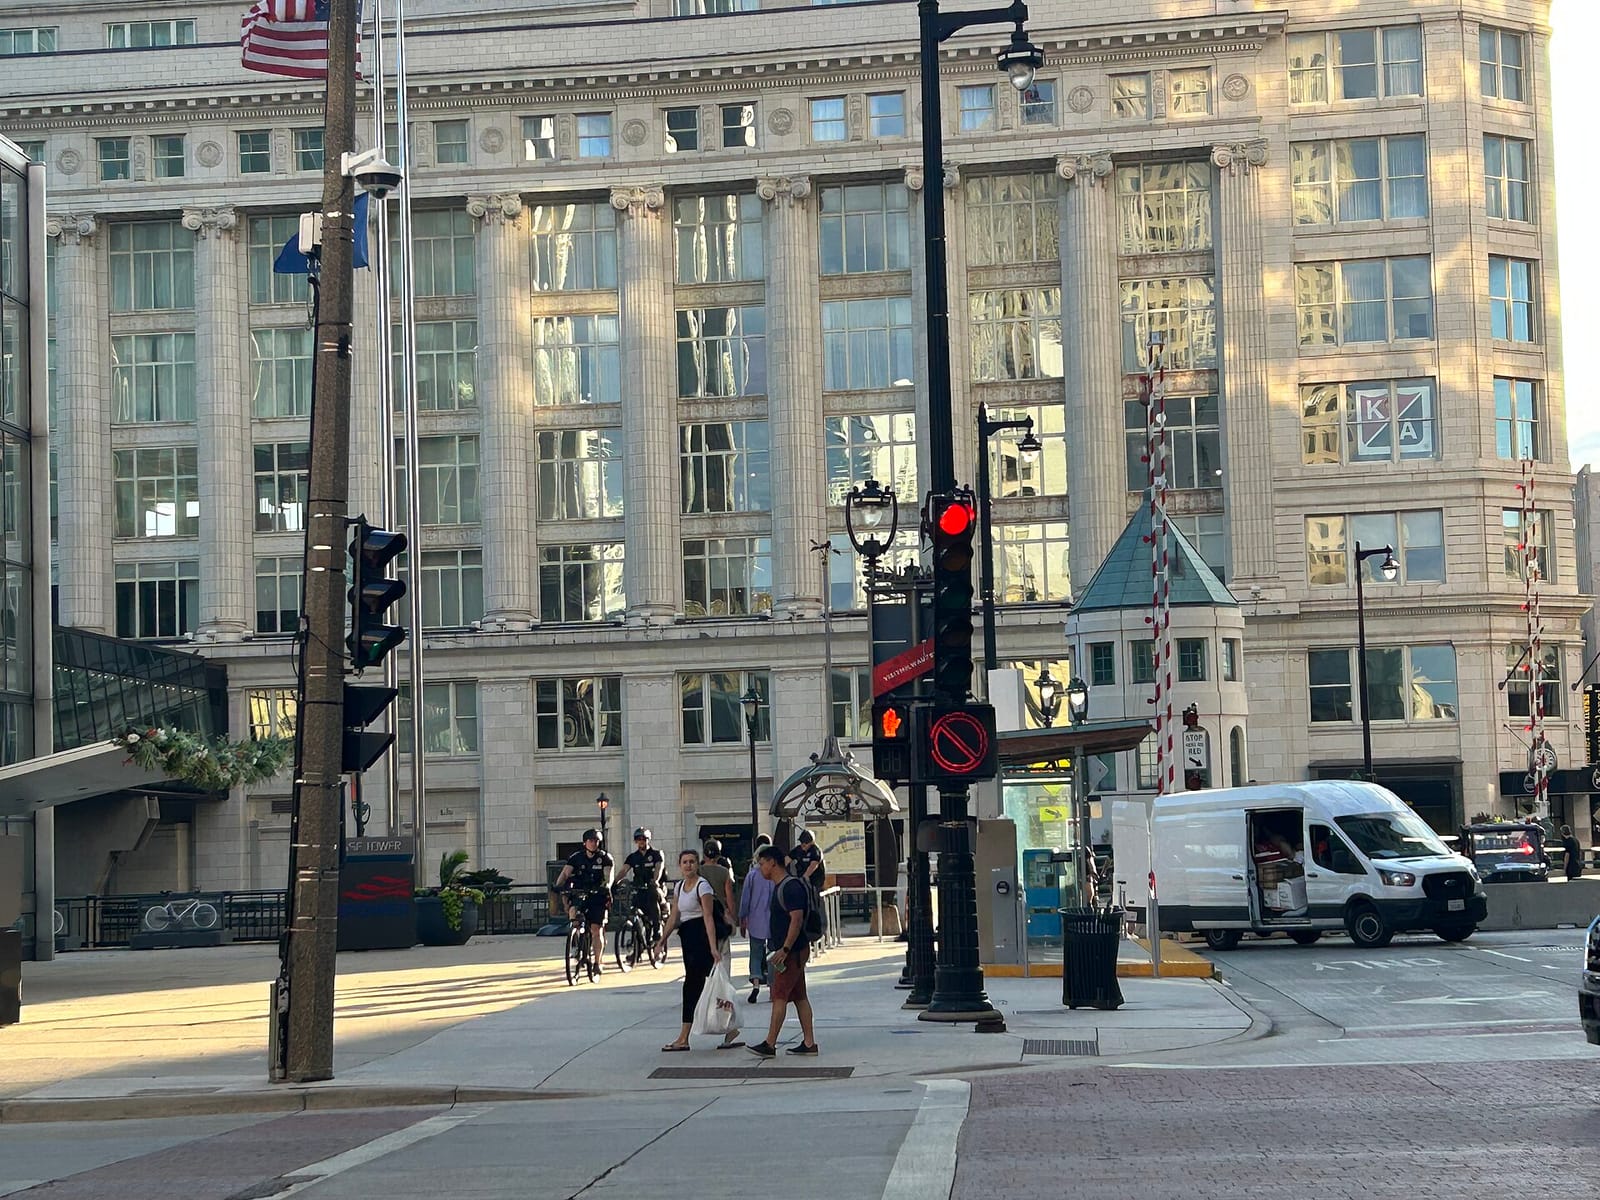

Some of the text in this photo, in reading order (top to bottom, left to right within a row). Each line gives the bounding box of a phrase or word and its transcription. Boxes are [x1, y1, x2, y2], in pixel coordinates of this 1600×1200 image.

[1366, 399, 1385, 420] K
[1400, 421, 1418, 440] A
[1185, 734, 1203, 742] STOP
[366, 840, 402, 851] TOWER
